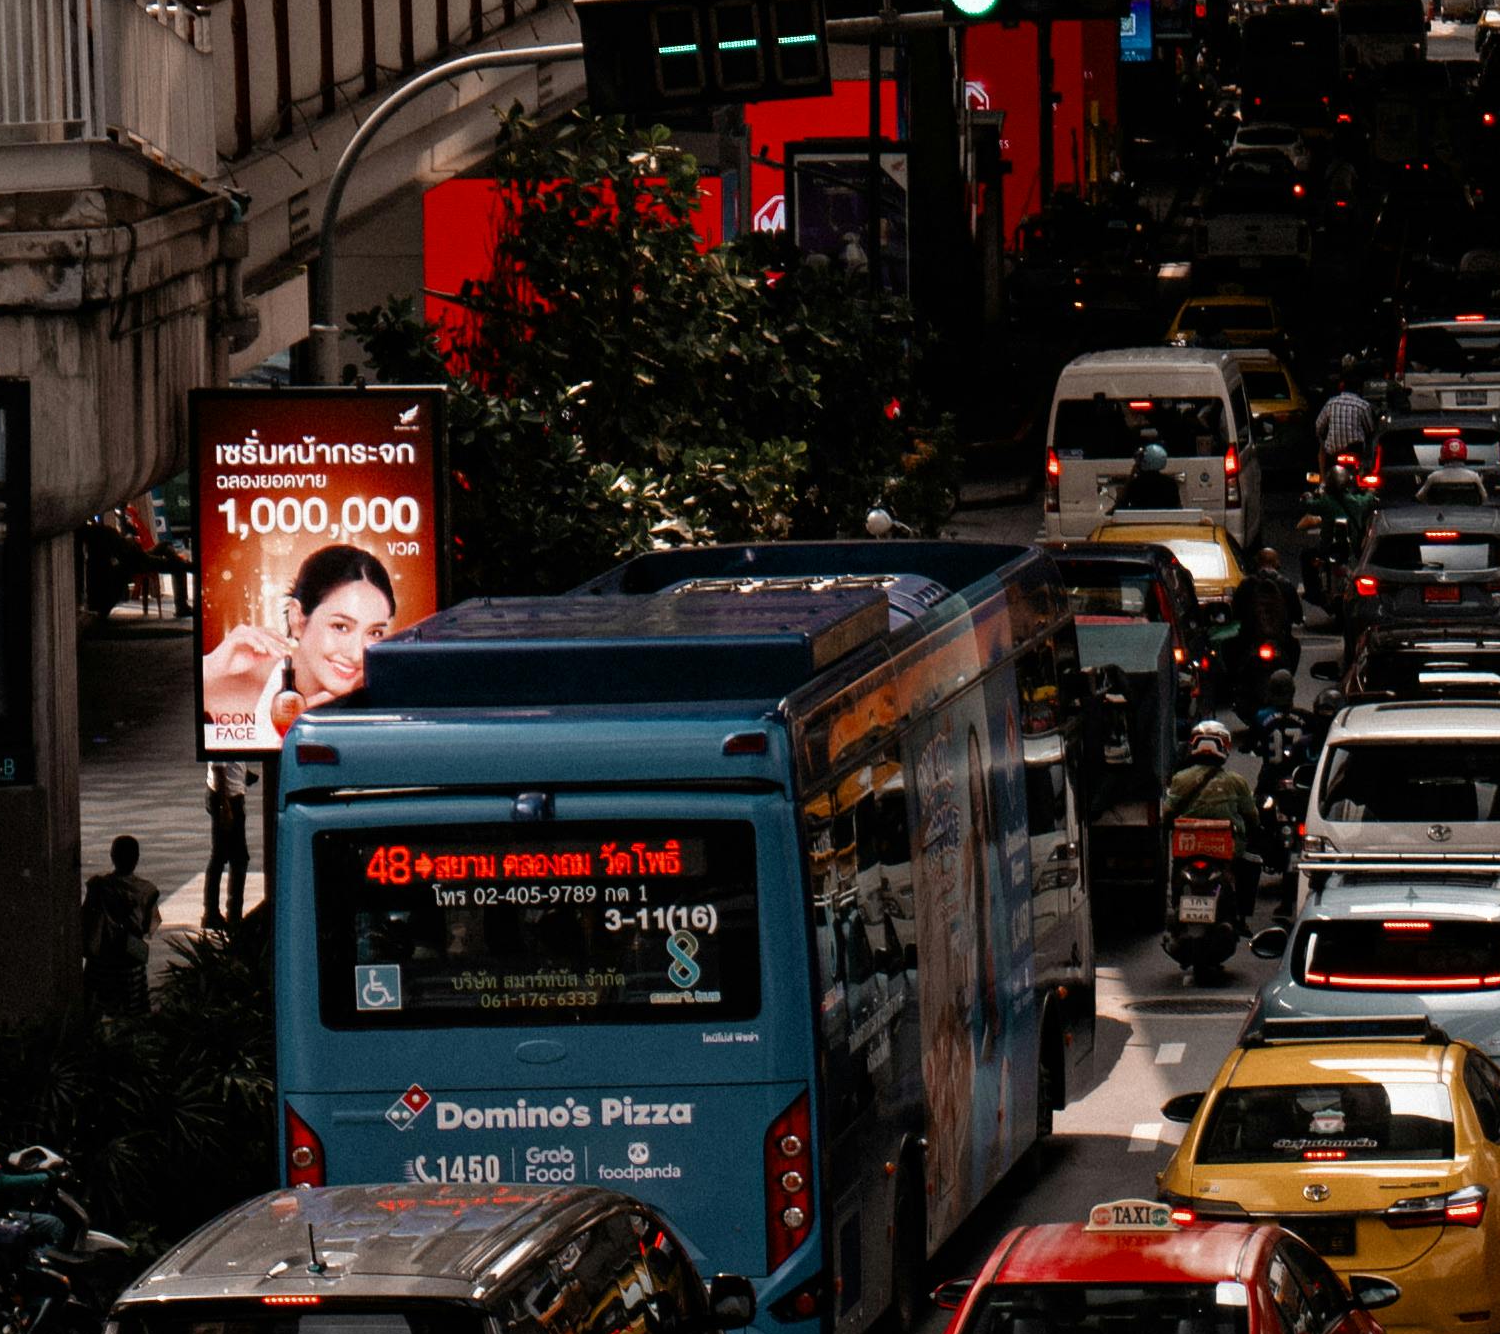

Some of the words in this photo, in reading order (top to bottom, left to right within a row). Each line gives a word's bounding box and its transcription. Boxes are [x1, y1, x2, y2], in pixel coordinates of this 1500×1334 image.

[215, 430, 417, 466] เซรั่มหน้ากระจก
[215, 474, 328, 491] ฉลองยอดขาย
[216, 496, 422, 540] 1,000,000
[386, 540, 421, 557] ขวด
[216, 727, 257, 741] FACE
[366, 845, 411, 884] 48
[431, 883, 467, 910] โทร
[473, 884, 597, 906] 02-405-9789
[603, 886, 630, 905] กด
[639, 885, 648, 903] 1
[603, 905, 719, 937] 3-11(16)
[450, 970, 495, 994] บริษัท
[479, 991, 599, 1009] 061-176-6333
[436, 1097, 590, 1131] Domino's
[600, 1096, 693, 1128] Pizza
[524, 1146, 575, 1166] Grab
[437, 1153, 501, 1185] 1450
[524, 1164, 576, 1183] Food
[598, 1161, 682, 1183] foodpanda
[1112, 1205, 1152, 1225] TAXI
